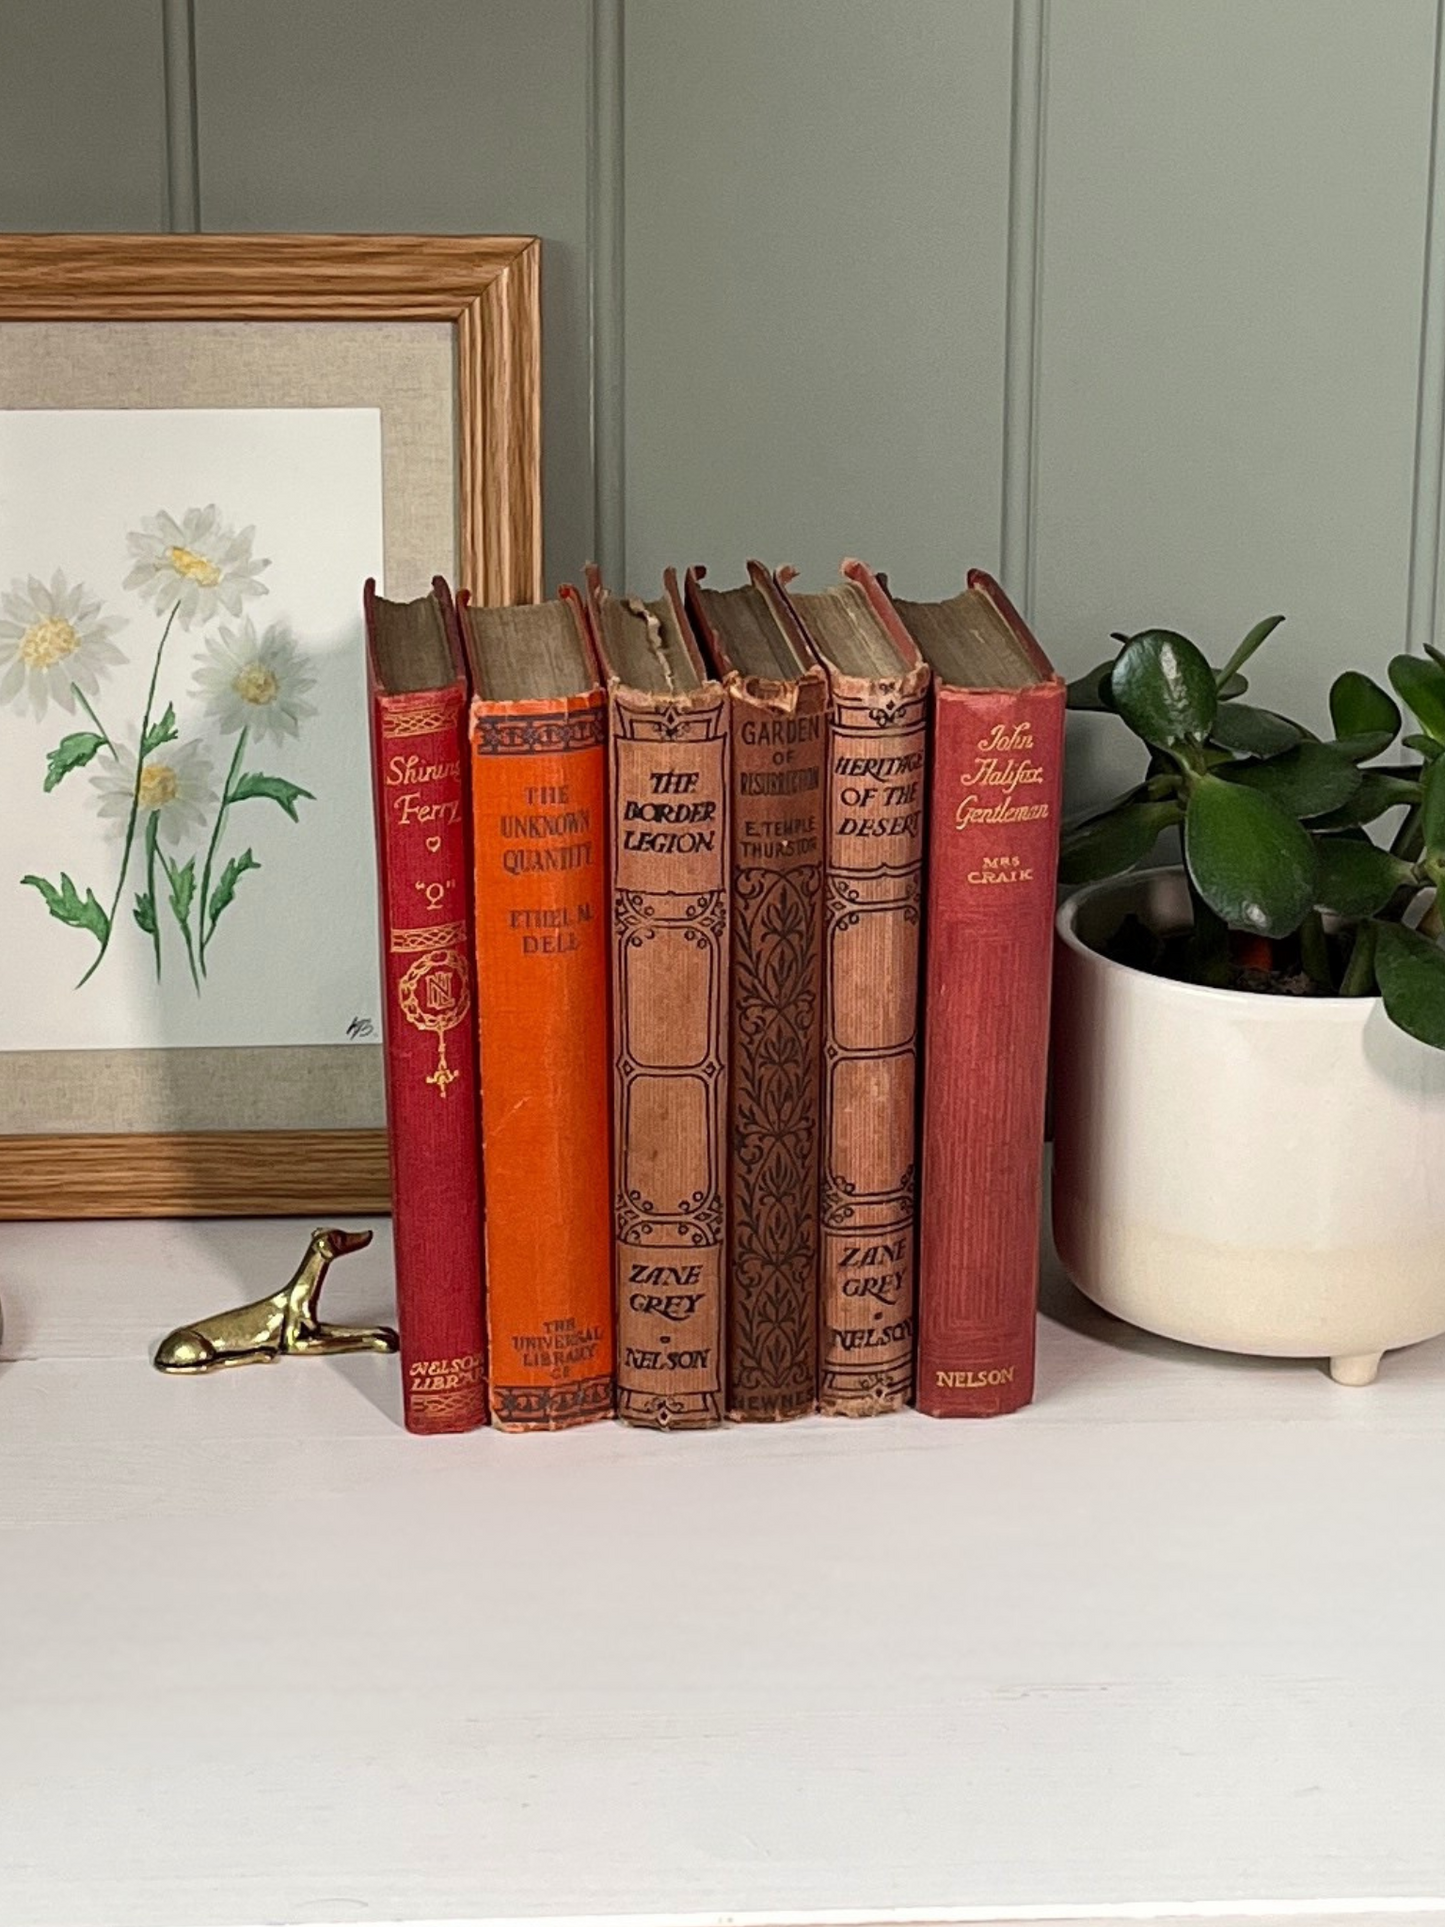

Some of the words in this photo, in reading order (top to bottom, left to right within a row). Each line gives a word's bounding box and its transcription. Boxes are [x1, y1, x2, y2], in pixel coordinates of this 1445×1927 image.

[741, 715, 820, 746] GARDEN
[978, 722, 1034, 751] John
[772, 751, 795, 766] OF
[835, 752, 924, 783] HERITAGE
[525, 784, 569, 805] THE
[650, 770, 699, 794] THE
[740, 767, 820, 796] RESURRECTION
[841, 787, 878, 807] OF
[883, 781, 918, 807] THE
[394, 792, 462, 825] Ferry
[624, 801, 716, 823] BORDER
[955, 794, 1049, 830] Gentleman
[500, 809, 591, 839] UNKNOWN
[837, 810, 922, 838] DESERT
[624, 831, 715, 854] LEGION
[502, 841, 594, 876] QUANTITY
[967, 868, 1034, 884] CRAIK
[522, 932, 578, 955] DELL
[839, 1238, 907, 1267] ZANE
[628, 1264, 703, 1286] ZANE
[842, 1268, 907, 1306] GREY
[629, 1293, 705, 1322] GREY
[543, 1317, 576, 1334] THE
[832, 1318, 914, 1351] NELSON
[511, 1326, 604, 1352] UNIVERSAL
[523, 1343, 598, 1368] LIBRARY
[624, 1349, 711, 1370] NELSON
[936, 1366, 1015, 1388] NELSON
